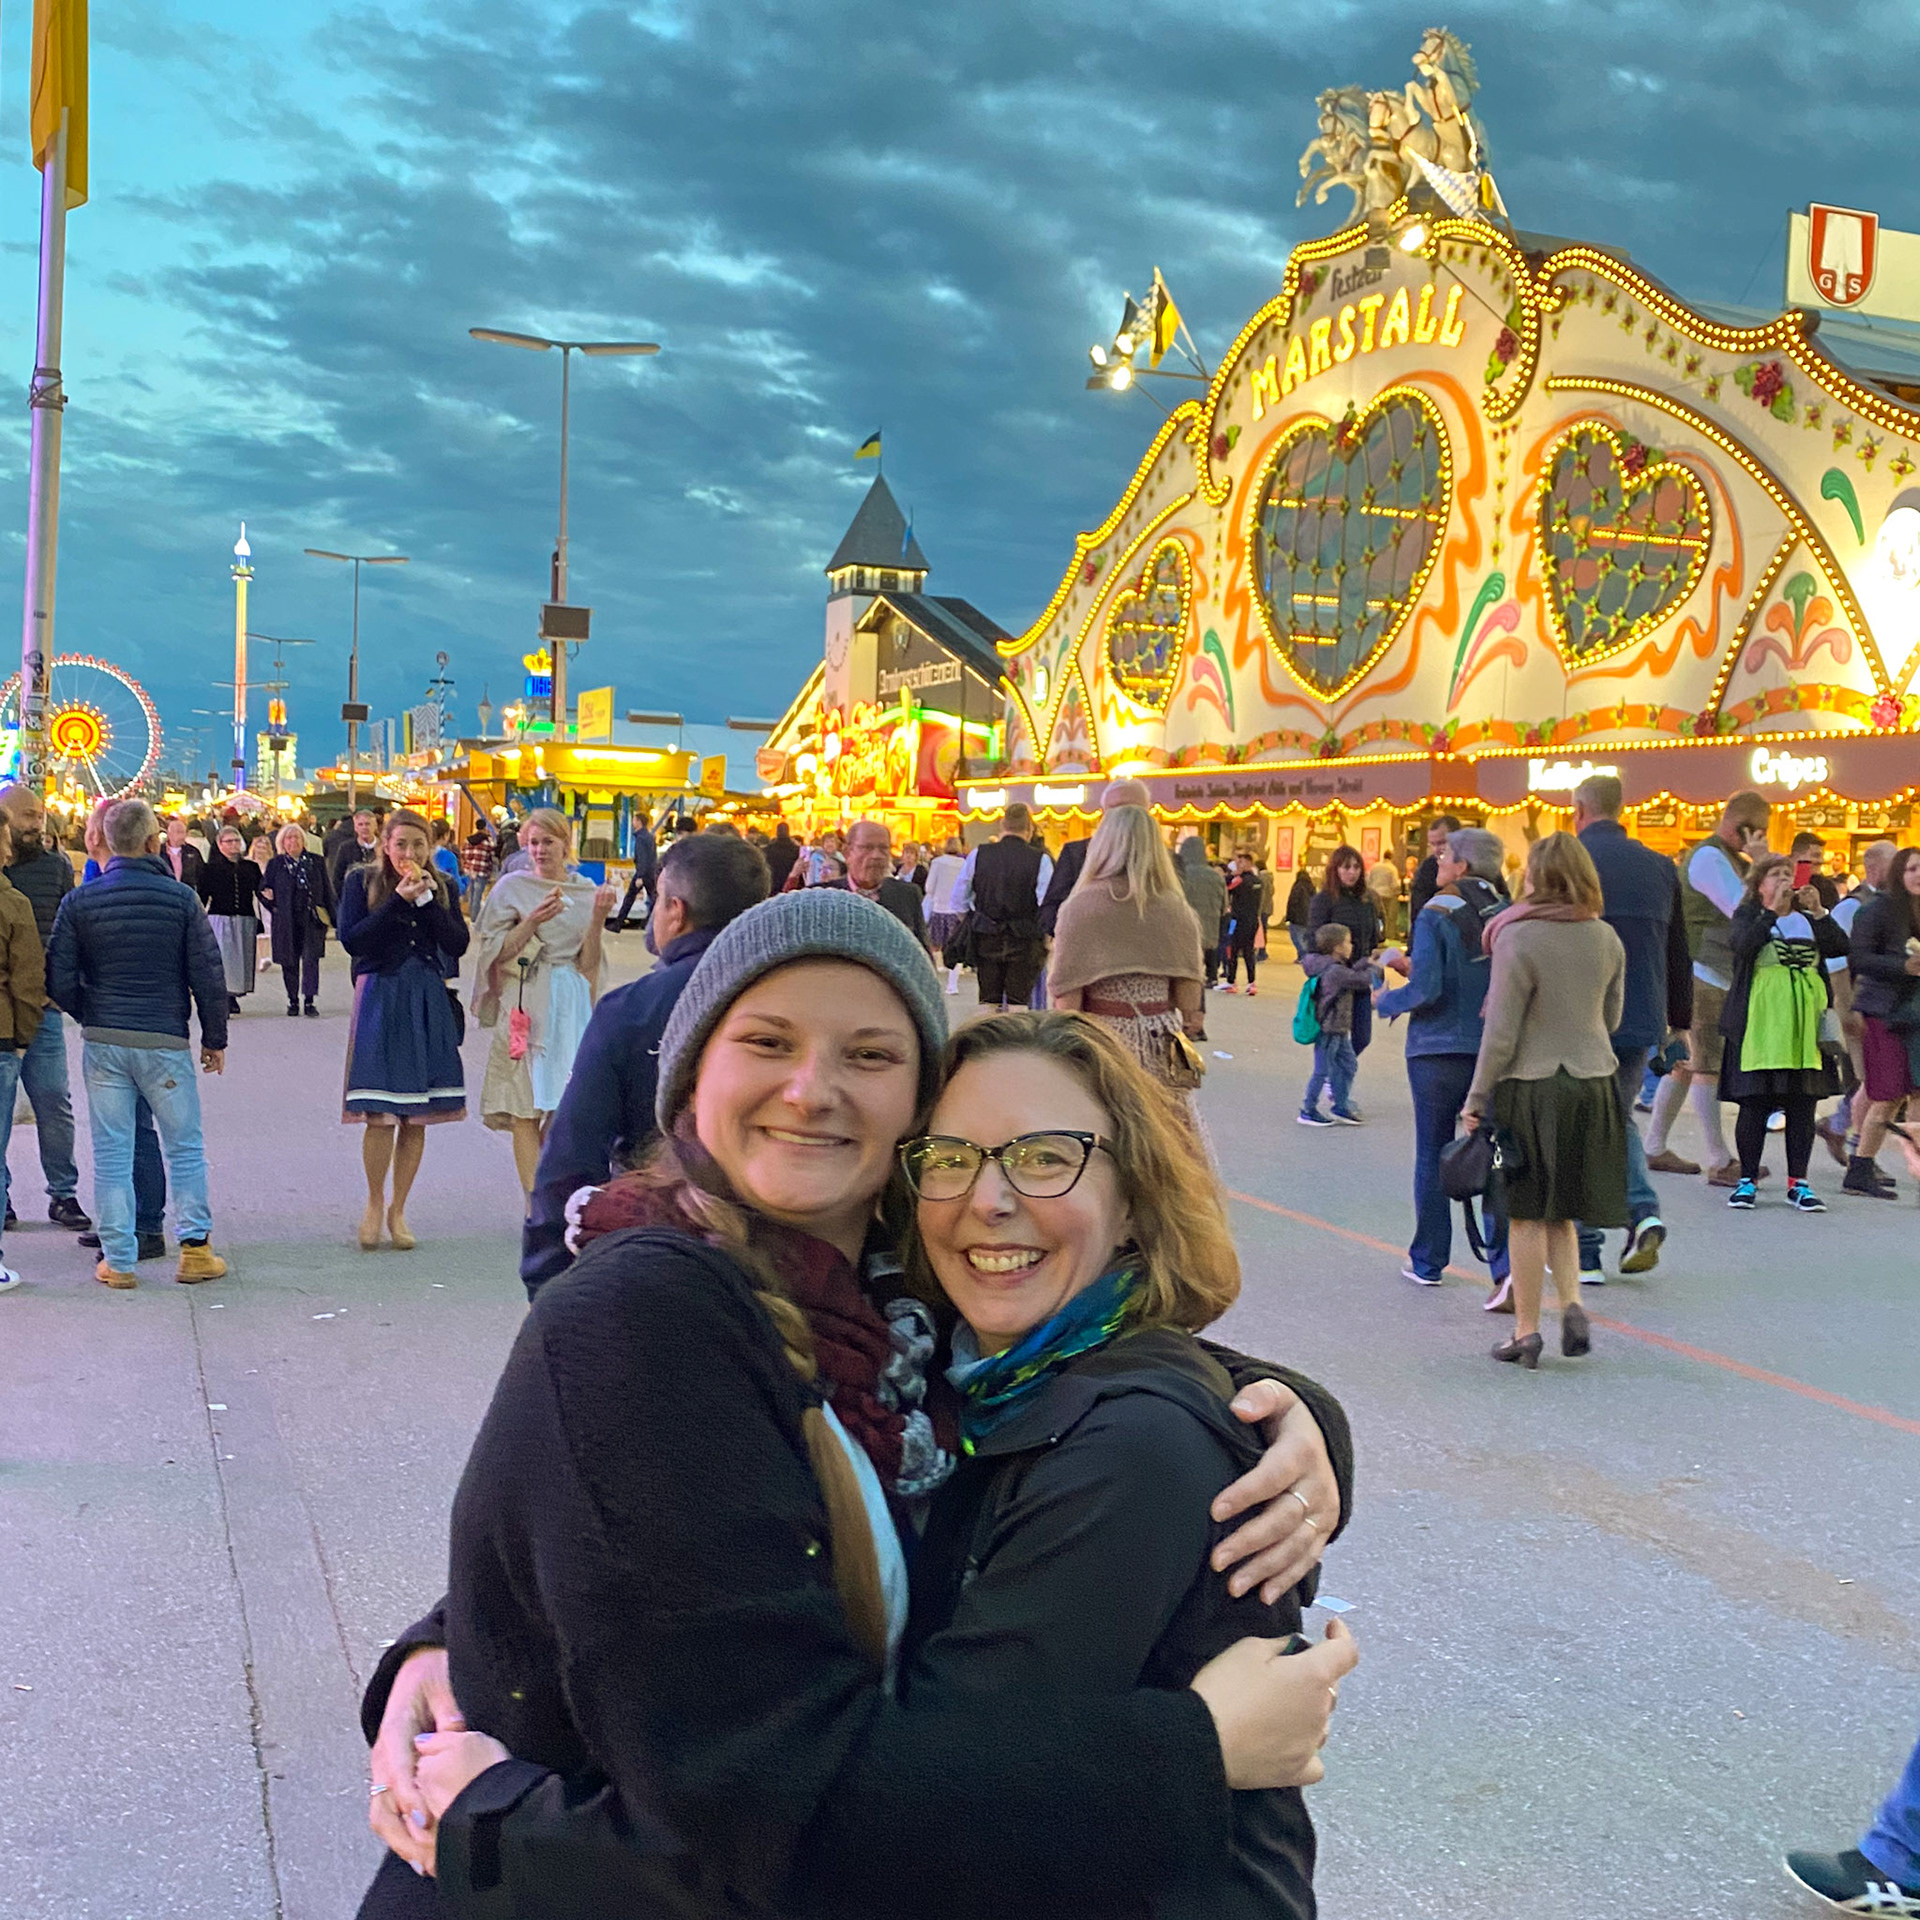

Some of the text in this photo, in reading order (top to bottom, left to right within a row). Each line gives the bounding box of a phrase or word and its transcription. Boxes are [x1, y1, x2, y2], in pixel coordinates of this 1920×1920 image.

[1819, 273, 1862, 295] G S
[1250, 283, 1466, 422] MARSTALL
